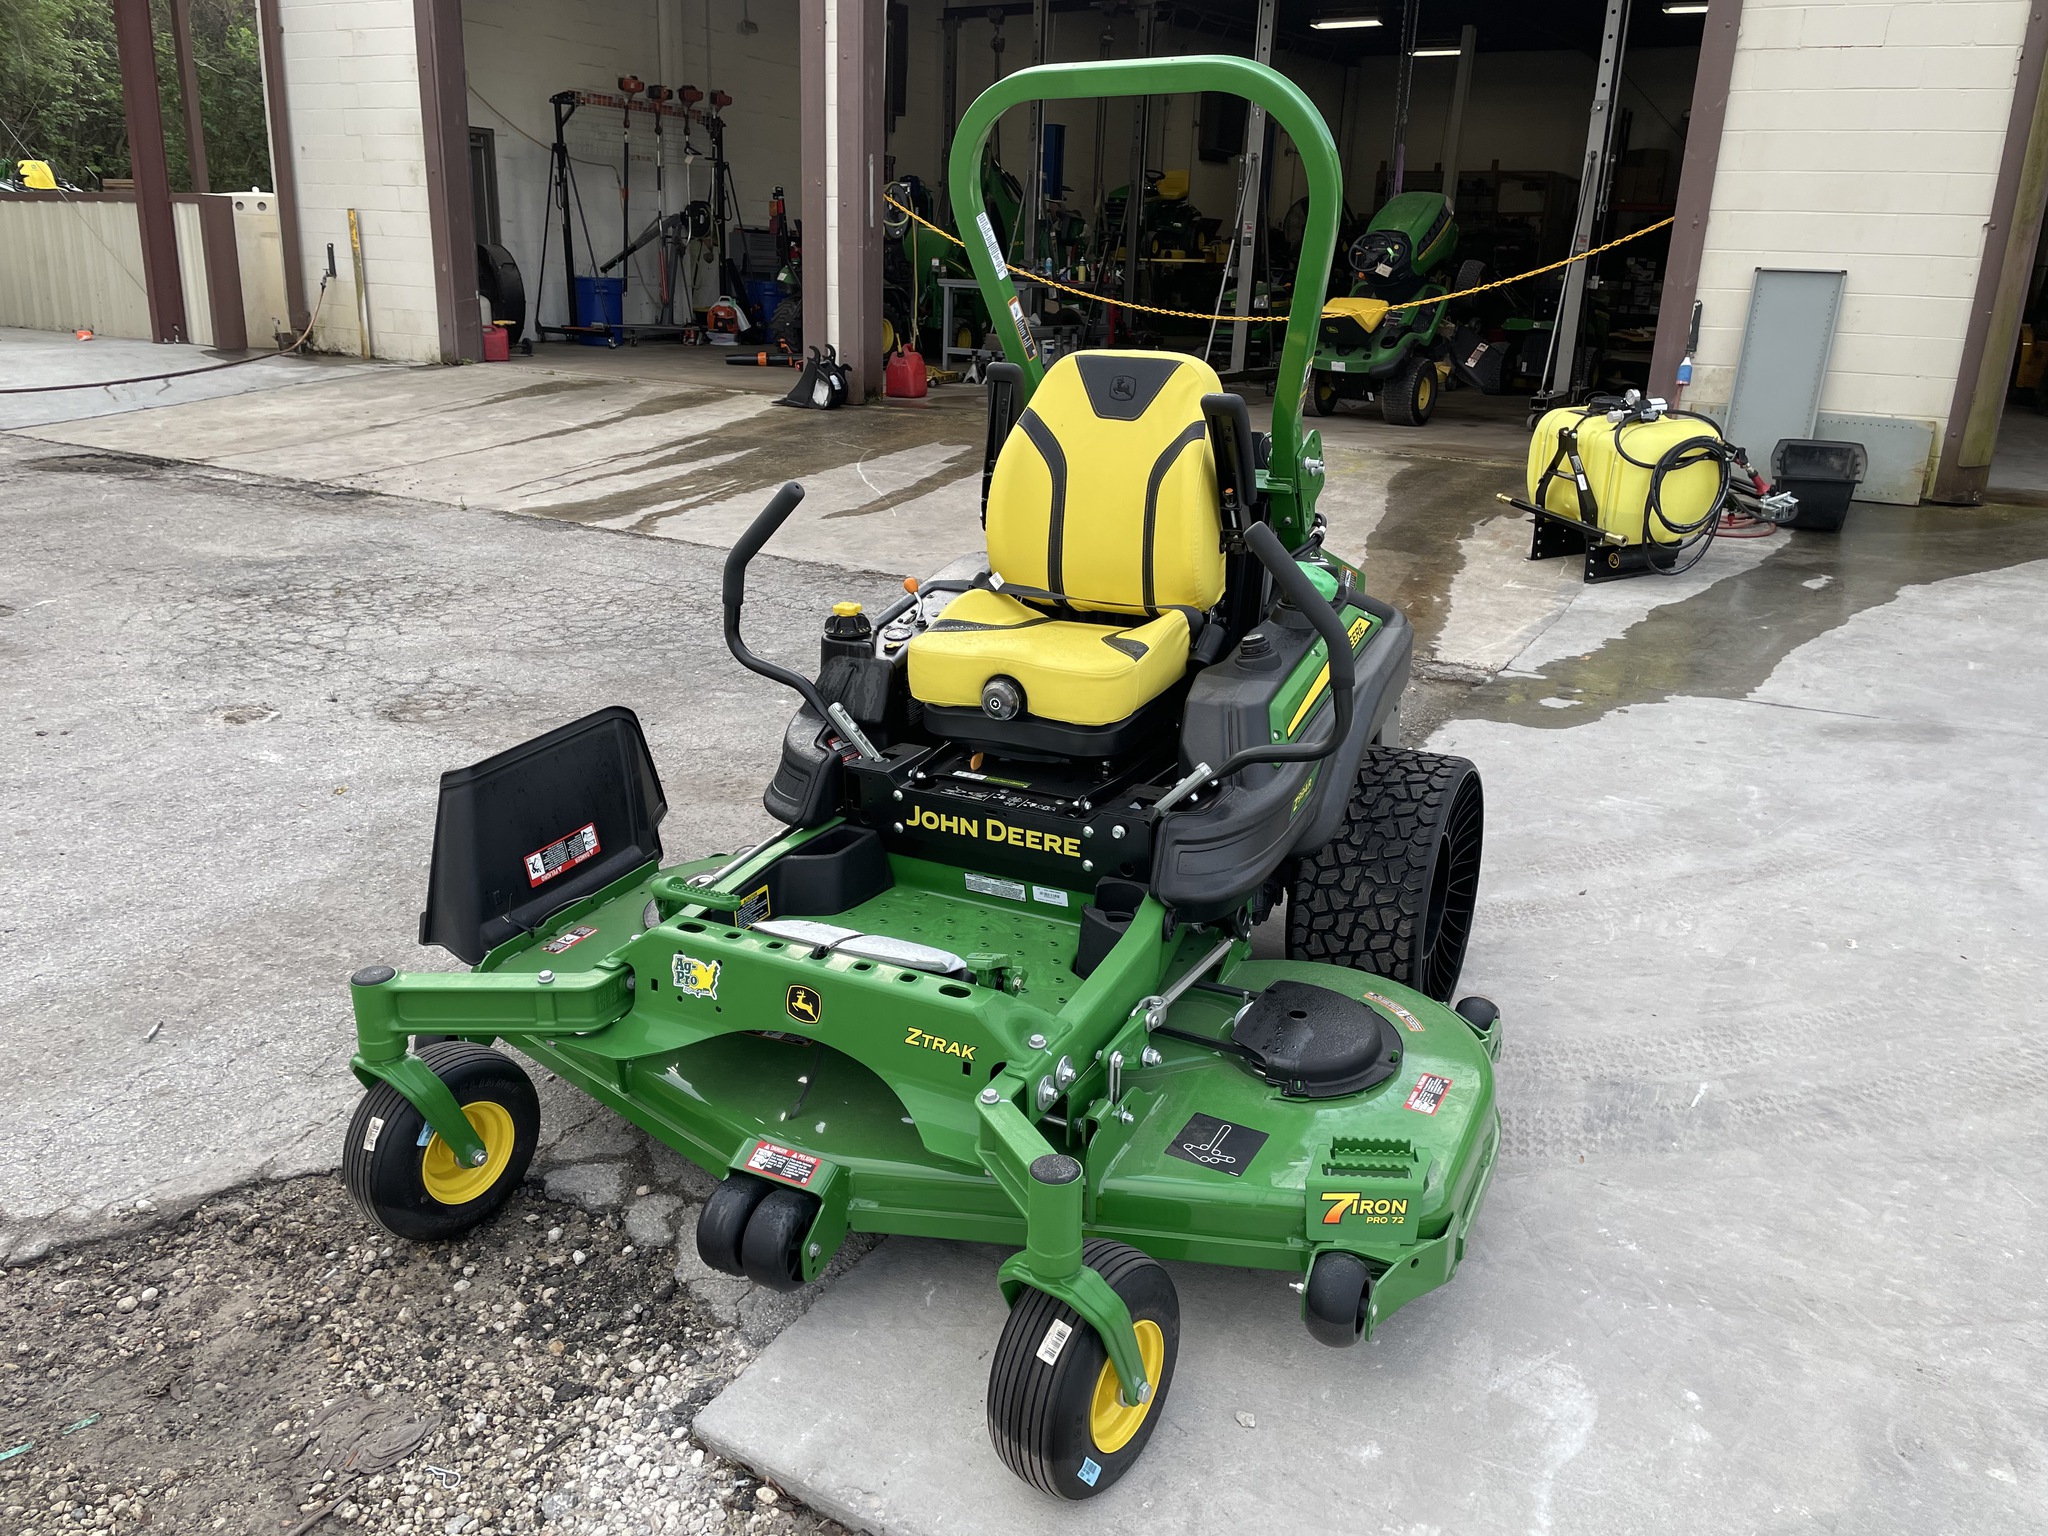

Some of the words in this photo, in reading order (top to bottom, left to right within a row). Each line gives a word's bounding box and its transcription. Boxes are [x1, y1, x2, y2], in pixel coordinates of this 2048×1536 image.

[1349, 622, 1366, 647] EERE
[905, 805, 979, 838] JOHN
[986, 818, 1081, 858] DEERE
[675, 957, 697, 974] Ag-
[676, 971, 698, 985] Pro
[904, 1026, 978, 1061] ZTRAK
[770, 1145, 789, 1155] DANGER
[797, 1153, 817, 1164] PELIGRO
[1366, 1216, 1389, 1224] PRO
[1391, 1216, 1405, 1224] 72
